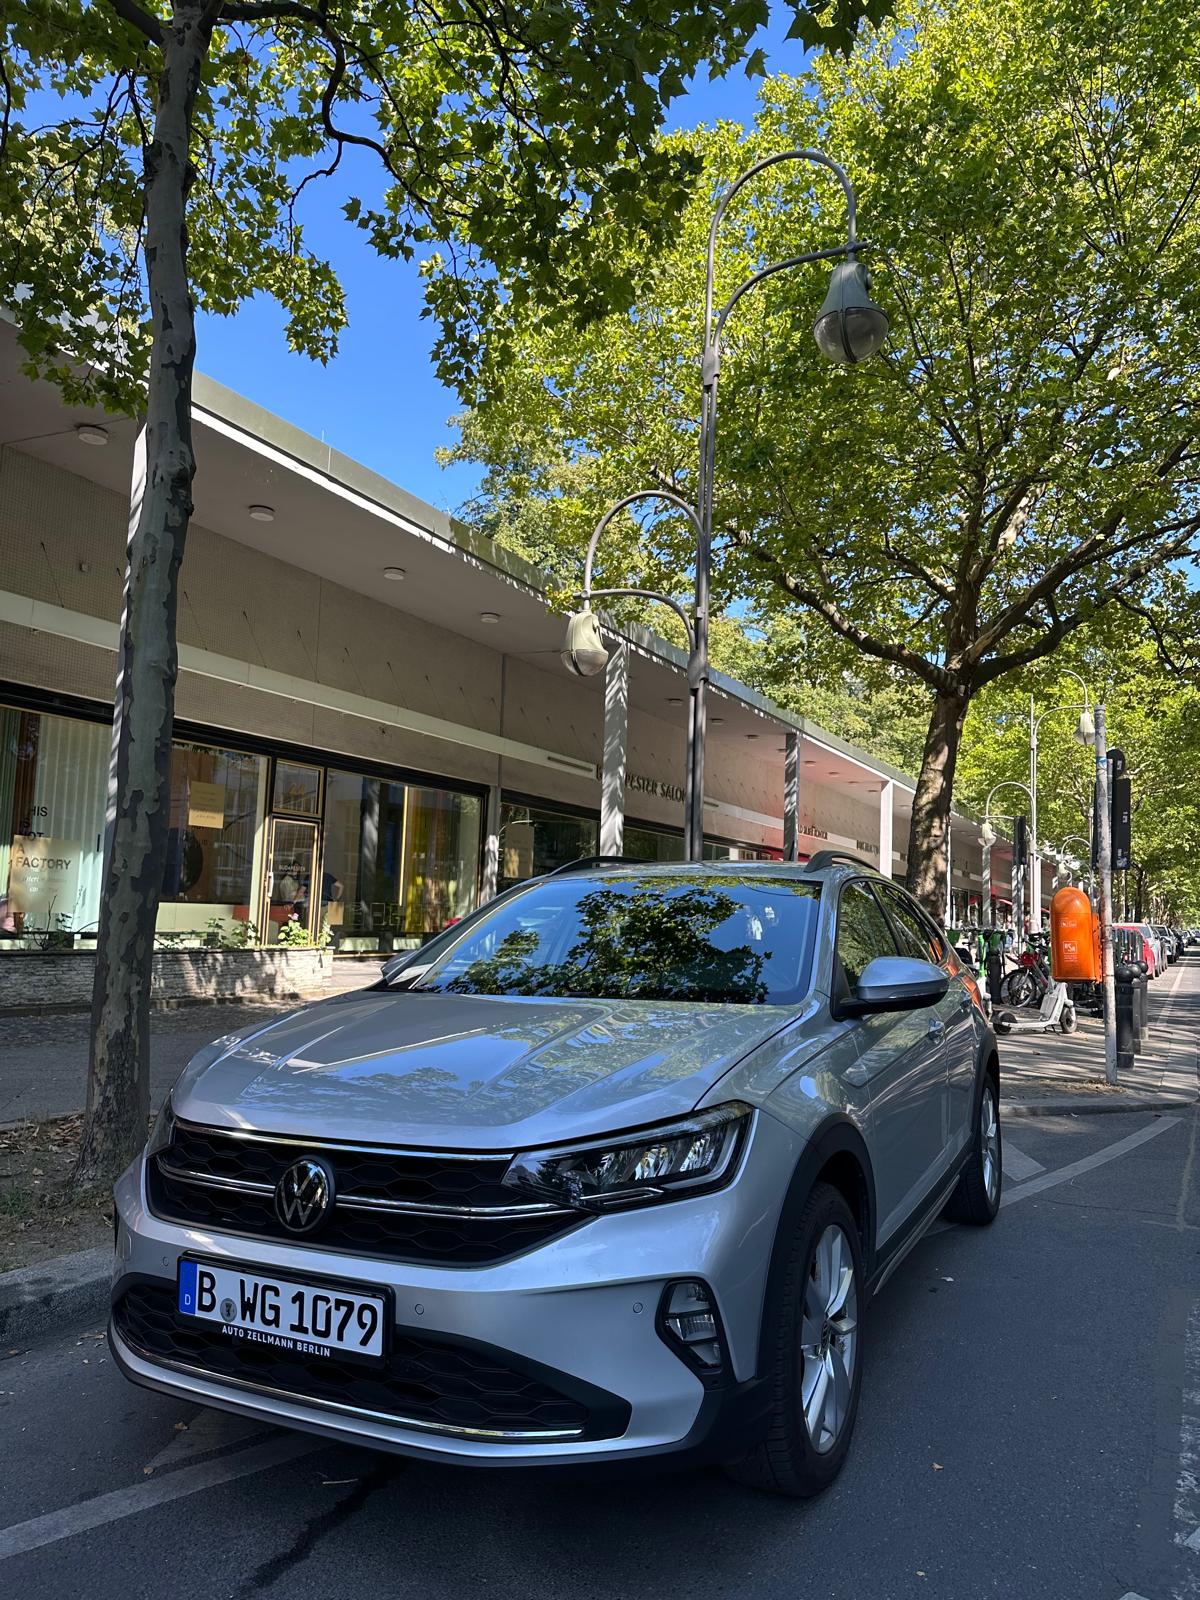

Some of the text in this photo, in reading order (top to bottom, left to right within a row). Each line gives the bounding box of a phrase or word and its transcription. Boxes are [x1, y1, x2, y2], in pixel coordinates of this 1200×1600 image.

[16, 857, 71, 870] FACTORY
[198, 1270, 379, 1347] B WG 1079
[221, 1325, 331, 1358] AUTO ZELLMANN BERLIN
